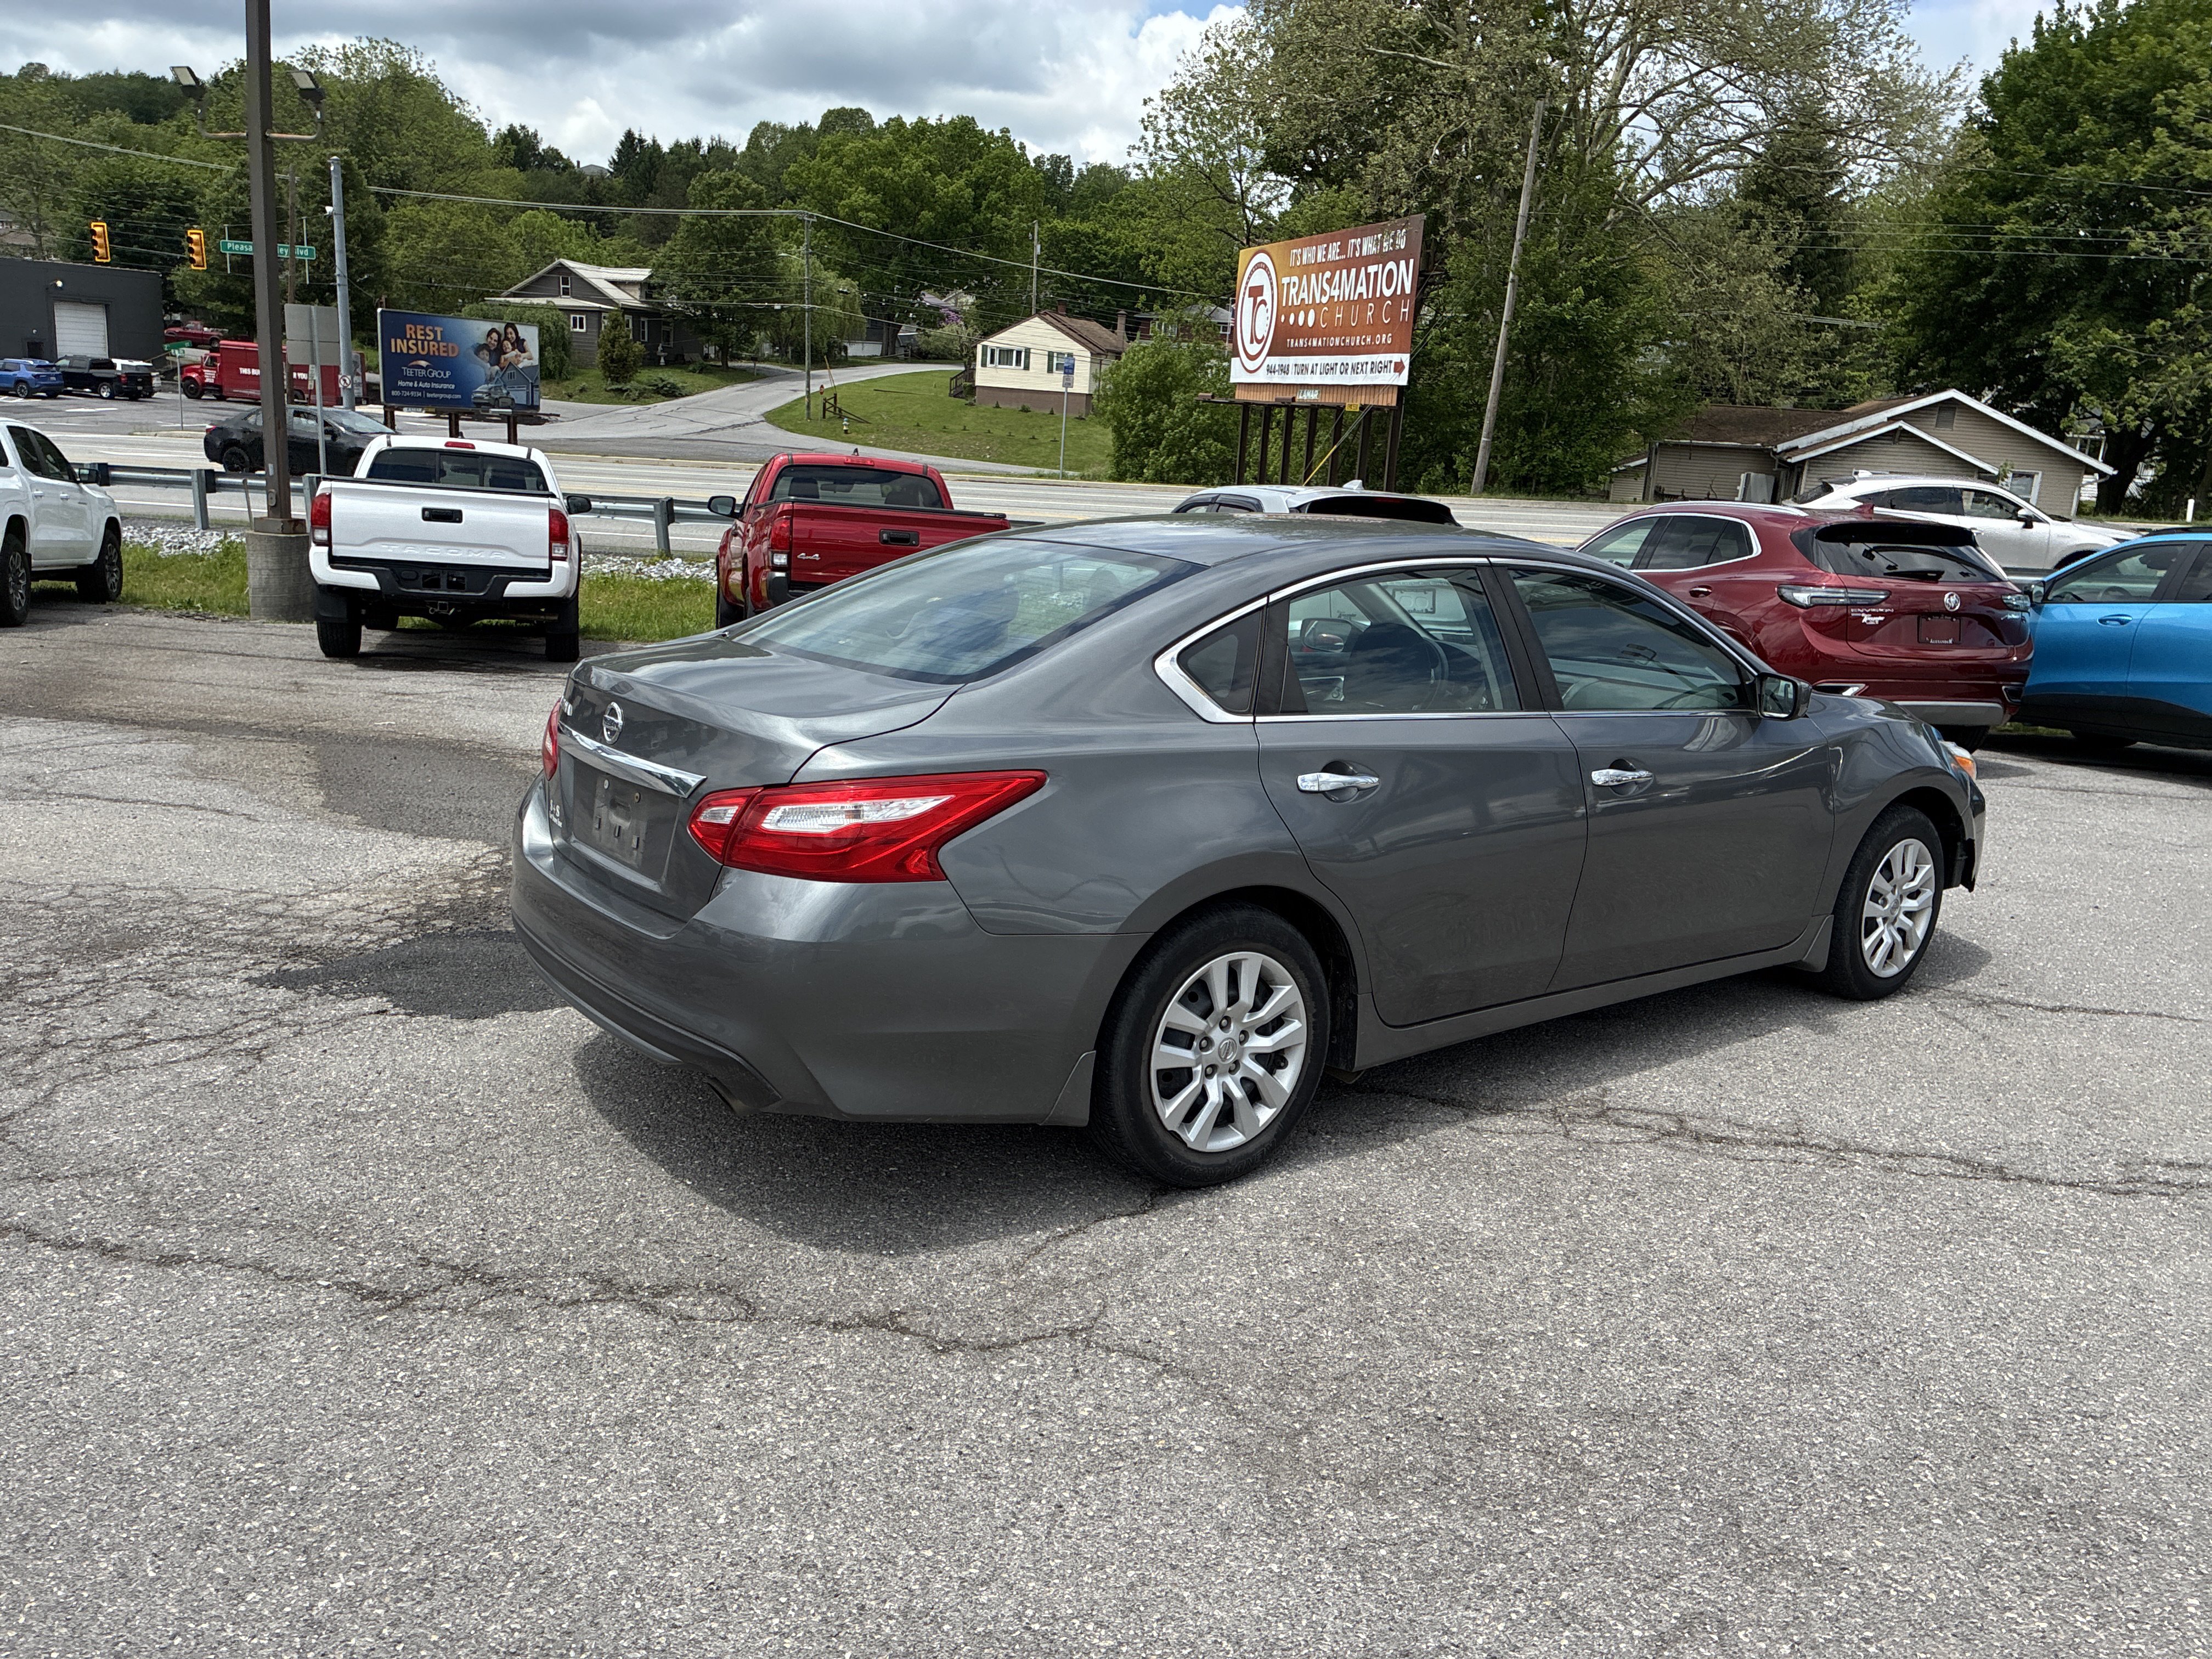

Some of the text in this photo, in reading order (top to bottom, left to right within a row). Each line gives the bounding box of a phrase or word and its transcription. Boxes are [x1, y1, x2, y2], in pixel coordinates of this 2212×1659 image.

[227, 242, 253, 252] Pleasa
[1290, 249, 1301, 267] IT'S
[1302, 246, 1316, 265] WHO
[1317, 244, 1327, 263] WE
[1347, 238, 1361, 258] IT'S
[1362, 234, 1382, 256] WHAT
[1281, 258, 1414, 307] TRANS4MATION
[1320, 299, 1410, 328] CHURCH
[406, 324, 443, 341] REST
[391, 338, 459, 357] INSURED
[1286, 334, 1392, 348] TRANS4MATIONCHURCH.ORG
[401, 366, 452, 379] TEETER GROUP
[1294, 364, 1308, 376] TURN
[1310, 363, 1318, 375] AT
[1319, 362, 1338, 375] LIGHT
[1339, 362, 1349, 375] OR
[1351, 361, 1369, 375] NEXT
[1370, 360, 1393, 374] RIGHT
[381, 544, 507, 560] TACOMA
